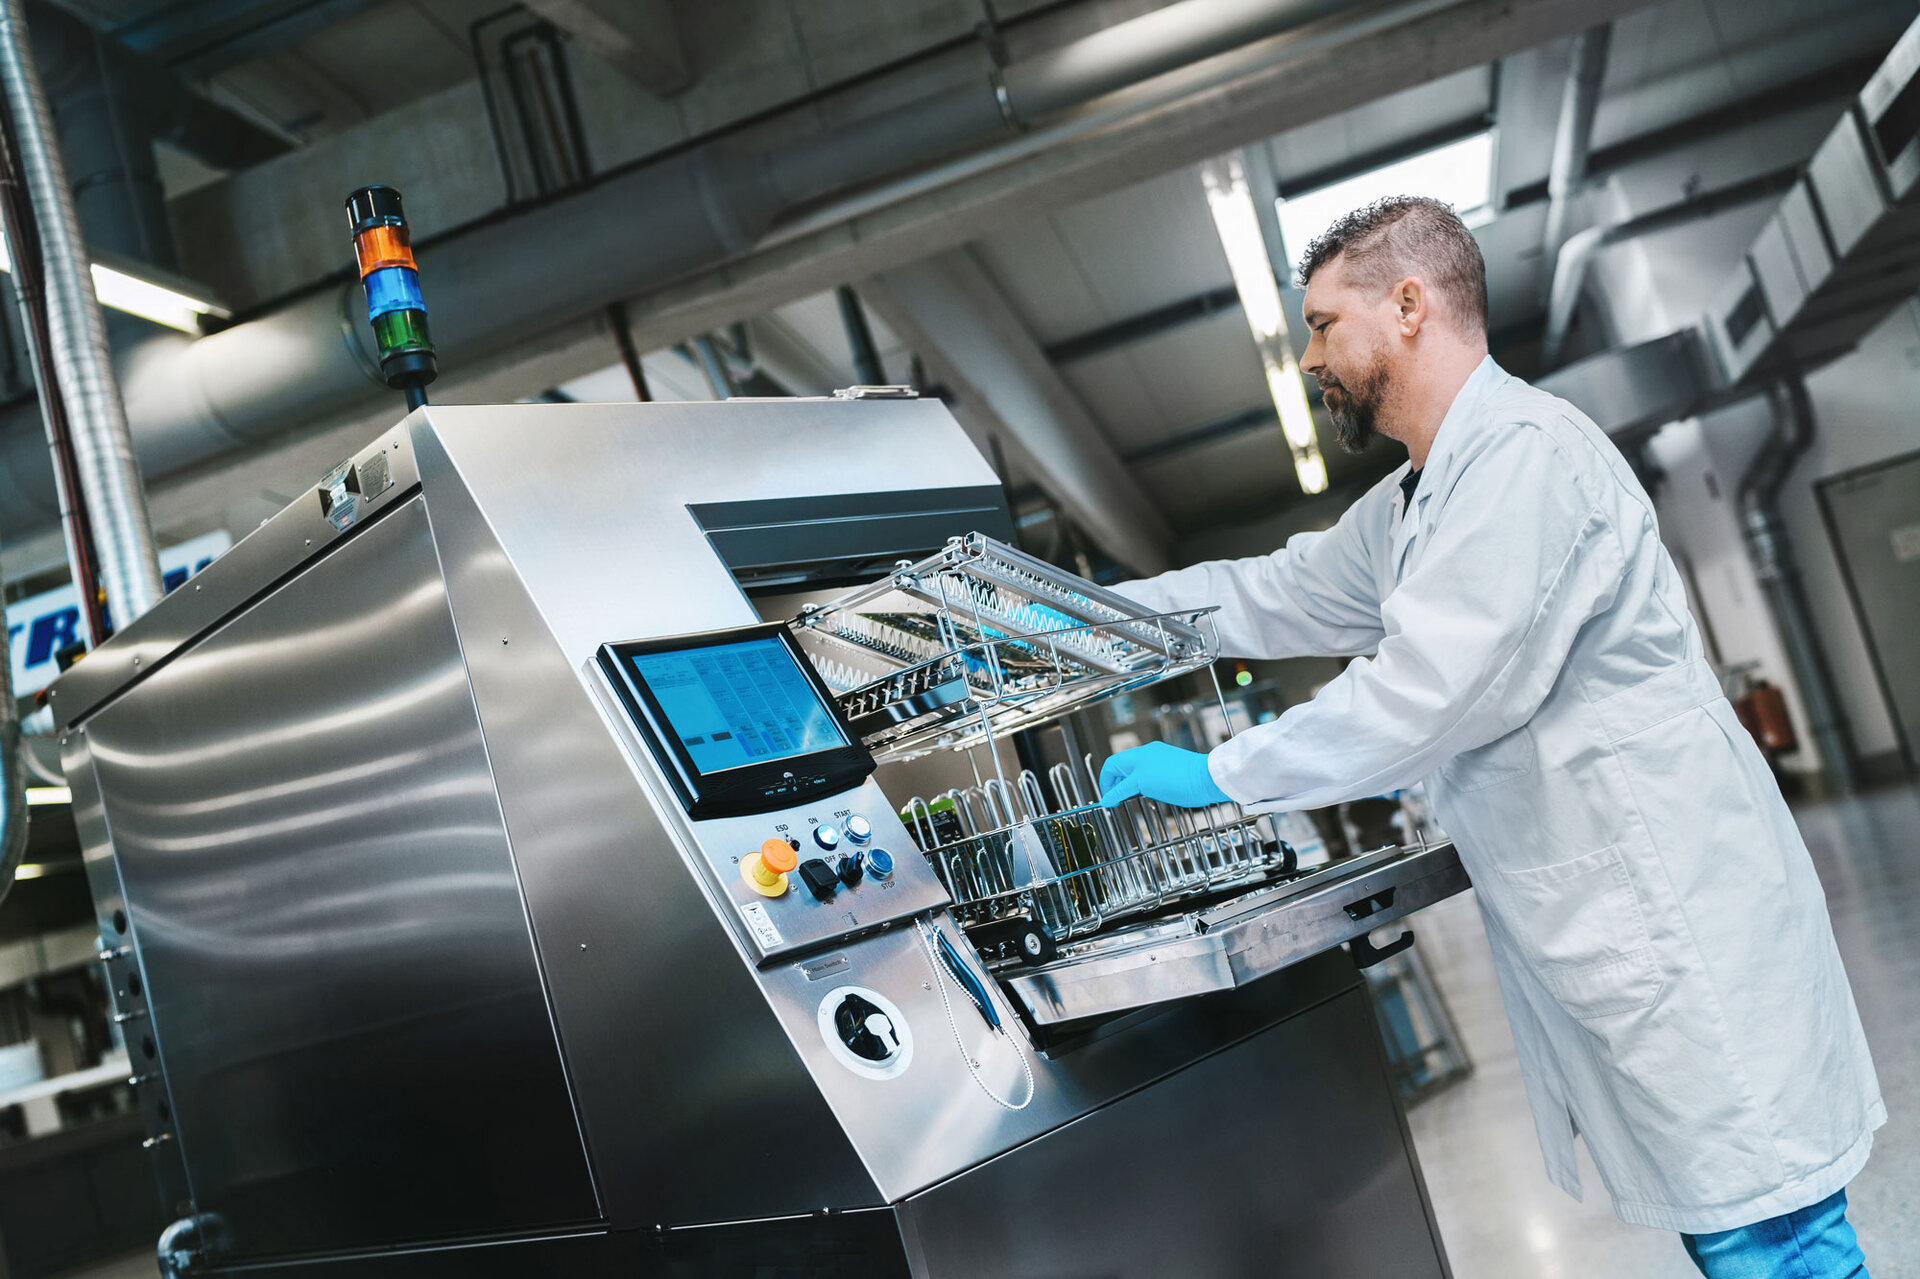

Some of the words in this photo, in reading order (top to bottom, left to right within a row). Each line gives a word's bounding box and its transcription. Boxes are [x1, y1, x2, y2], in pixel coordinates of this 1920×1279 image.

[833, 809, 851, 819] START
[775, 823, 789, 832] ESD
[824, 855, 836, 863] OFF
[881, 881, 895, 890] STOP
